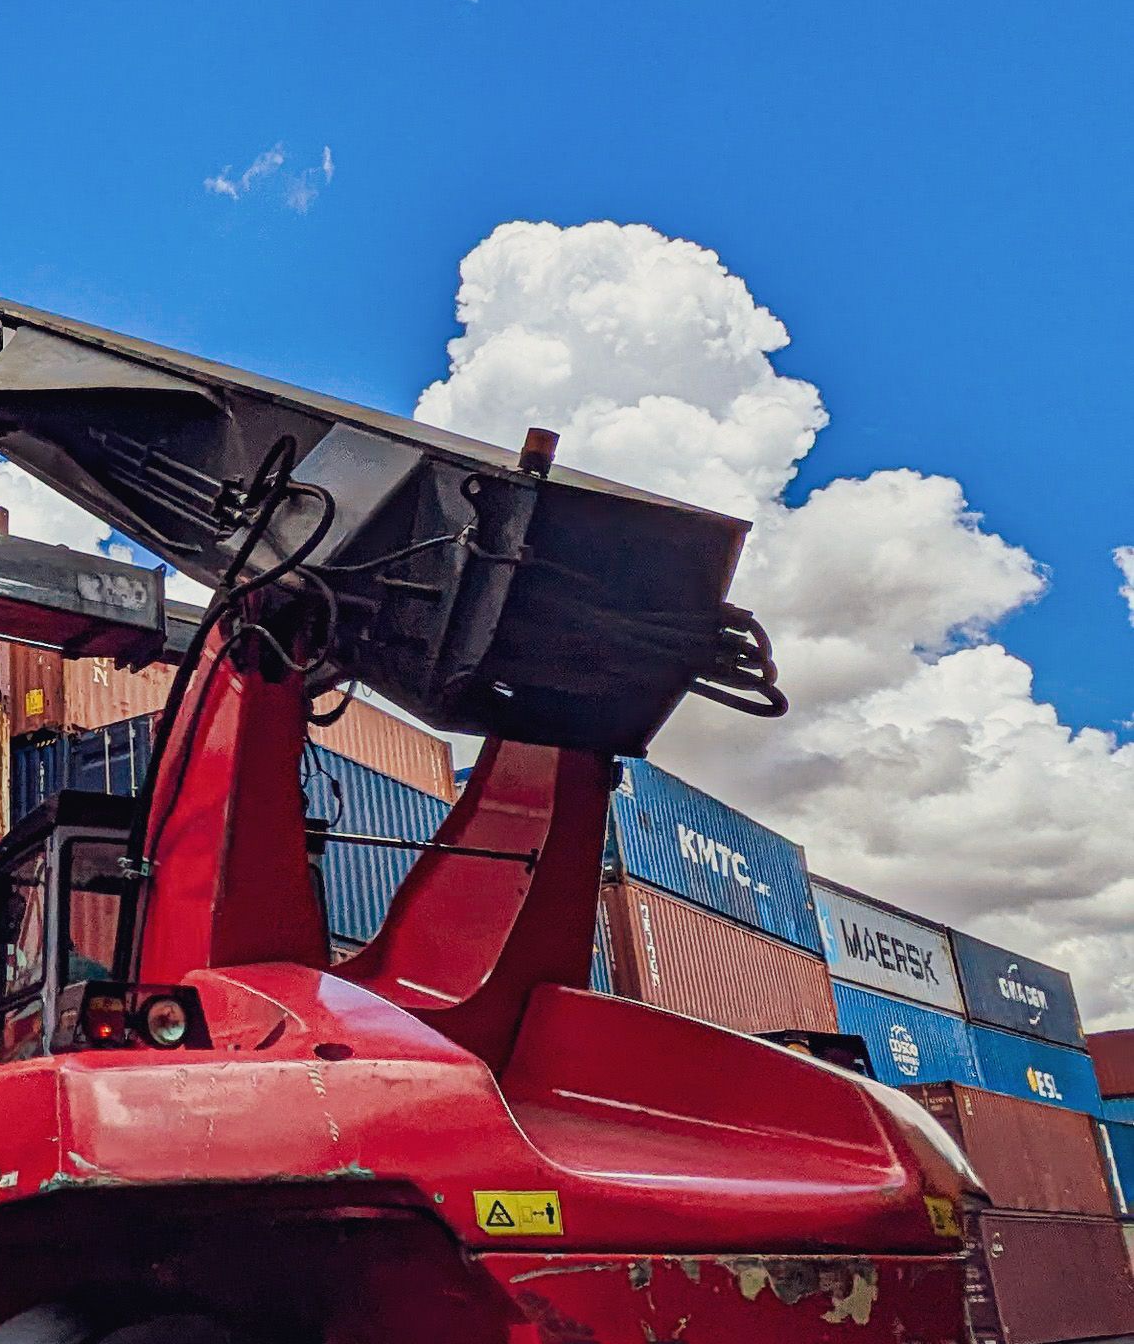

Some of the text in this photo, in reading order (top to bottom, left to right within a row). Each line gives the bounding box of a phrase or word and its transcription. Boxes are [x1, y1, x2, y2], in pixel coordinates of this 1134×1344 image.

[678, 823, 751, 889] KMTC
[840, 918, 940, 986] MAERSK
[998, 977, 1027, 1004] CMA
[1035, 1070, 1063, 1101] ESL
